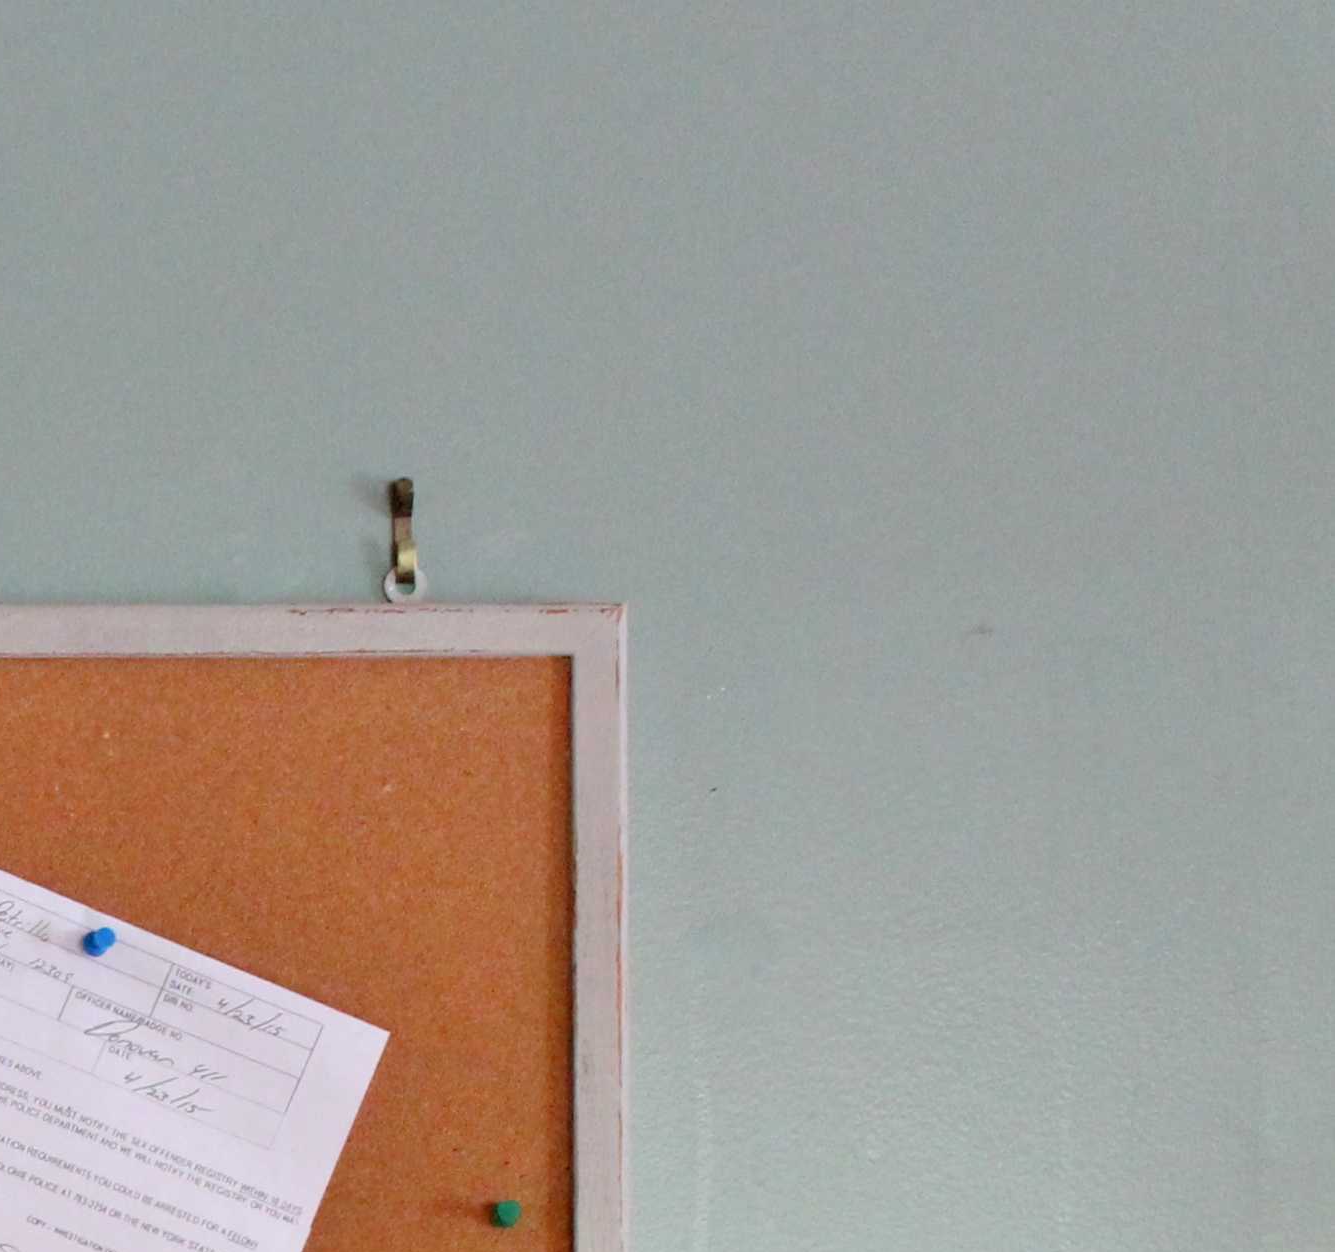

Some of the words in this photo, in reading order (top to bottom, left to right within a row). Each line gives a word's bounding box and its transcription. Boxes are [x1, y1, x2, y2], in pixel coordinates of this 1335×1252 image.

[74, 990, 111, 1011] OFFICER
[8, 1099, 41, 1119] POLICE
[41, 1112, 98, 1143] DEPARTMENT
[98, 1137, 118, 1151] AND
[118, 1145, 131, 1156] WE
[133, 1151, 152, 1165] WILL
[153, 1159, 185, 1179] NOTIFY
[185, 1173, 202, 1187] THE
[249, 1200, 263, 1212] OR
[263, 1206, 282, 1220] YOU
[31, 1094, 49, 1108] YOU
[52, 1103, 76, 1120] MUST
[80, 1114, 108, 1132] NOTIFY
[111, 1127, 127, 1141] THE
[130, 1135, 148, 1148] SEX
[148, 1143, 193, 1168] OFFENDER
[193, 1162, 238, 1187] REGISTRY
[27, 1174, 58, 1193] POLICE
[60, 1187, 71, 1198] AT
[108, 1207, 122, 1220] OR
[123, 1214, 139, 1227] THE
[140, 1221, 160, 1236] NEW
[161, 1229, 187, 1247] YORK
[92, 1174, 112, 1188] YOU
[111, 1182, 141, 1201] COULD
[140, 1194, 153, 1206] BE
[154, 1199, 200, 1225] ARRESTED
[200, 1218, 219, 1233] FOR
